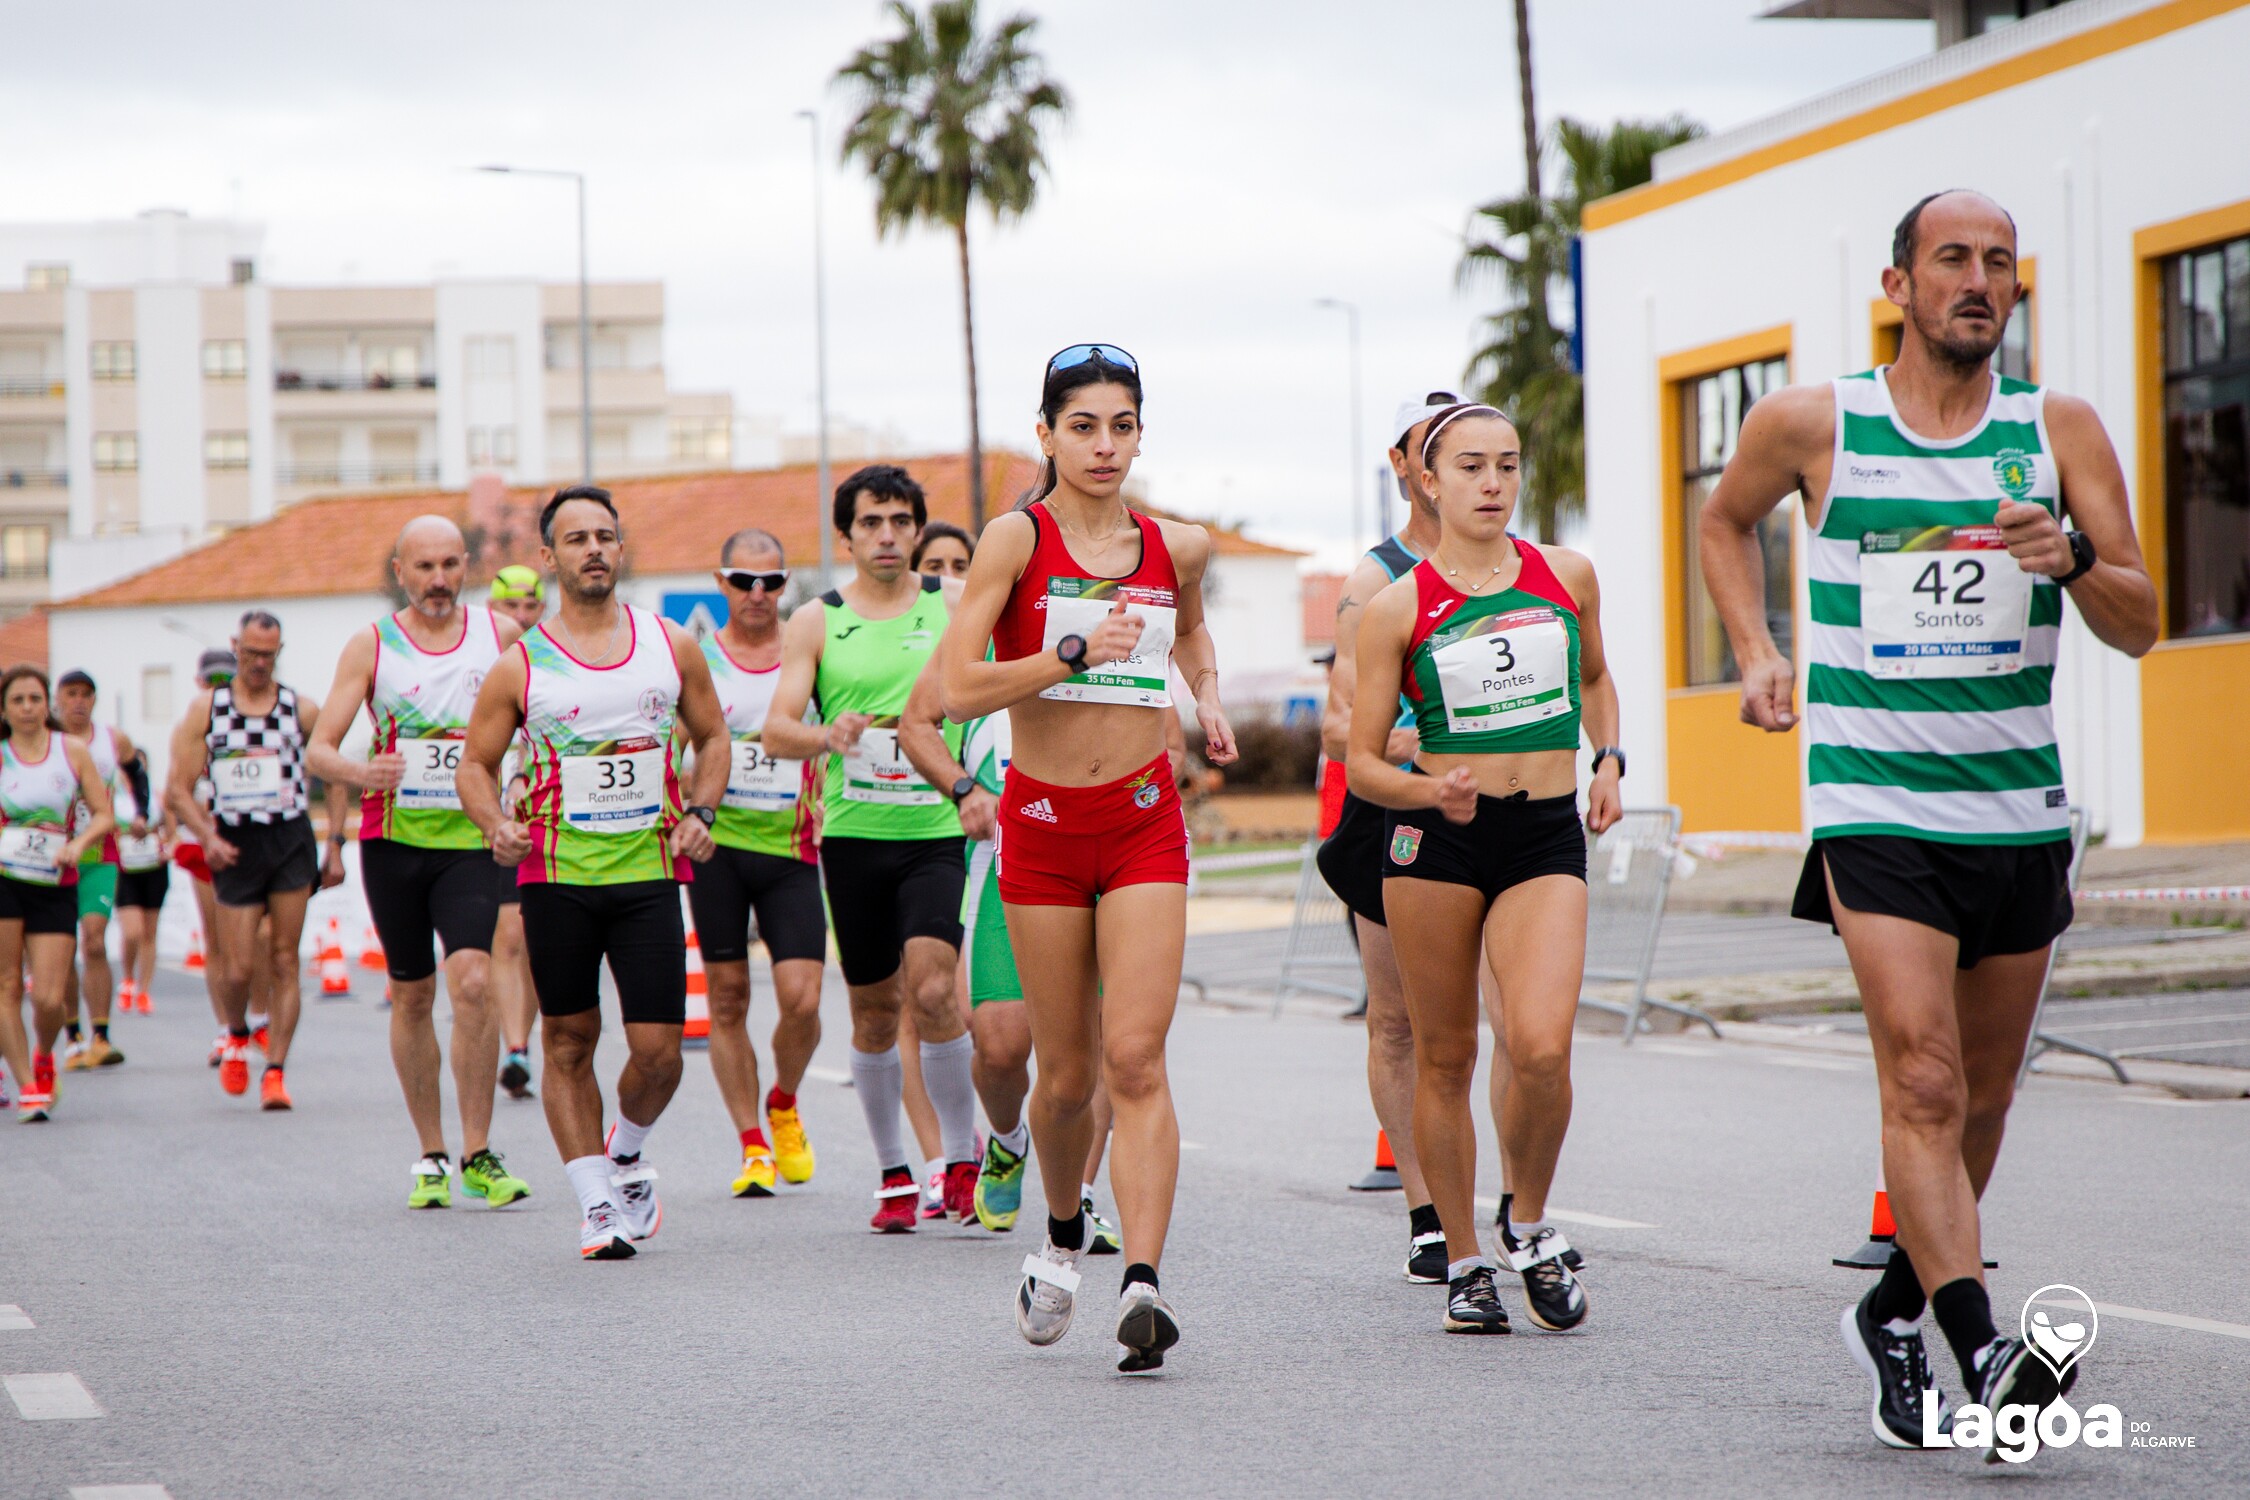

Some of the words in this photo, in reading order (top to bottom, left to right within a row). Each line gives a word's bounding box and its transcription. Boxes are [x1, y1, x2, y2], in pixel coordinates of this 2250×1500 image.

[1913, 559, 1985, 604] 42
[1915, 611, 1984, 628] Santos
[1488, 637, 1516, 673] 3
[1905, 645, 1917, 655] 20
[1921, 644, 1940, 655] Km
[1942, 643, 1963, 654] Vet
[1965, 643, 1993, 654] Masc
[1087, 674, 1098, 683] 35
[1100, 675, 1114, 684] Km
[1116, 676, 1135, 686] Fem
[1482, 673, 1535, 693] Pontes
[1489, 704, 1500, 713] 35
[1502, 701, 1516, 711] Km
[1517, 697, 1536, 708] Fem
[426, 744, 460, 770] 36
[743, 747, 777, 772] 34
[231, 760, 260, 780] 40
[423, 771, 454, 782] Coelh
[598, 759, 635, 789] 33
[589, 790, 643, 803] Ramalho
[1020, 807, 1058, 823] adidas
